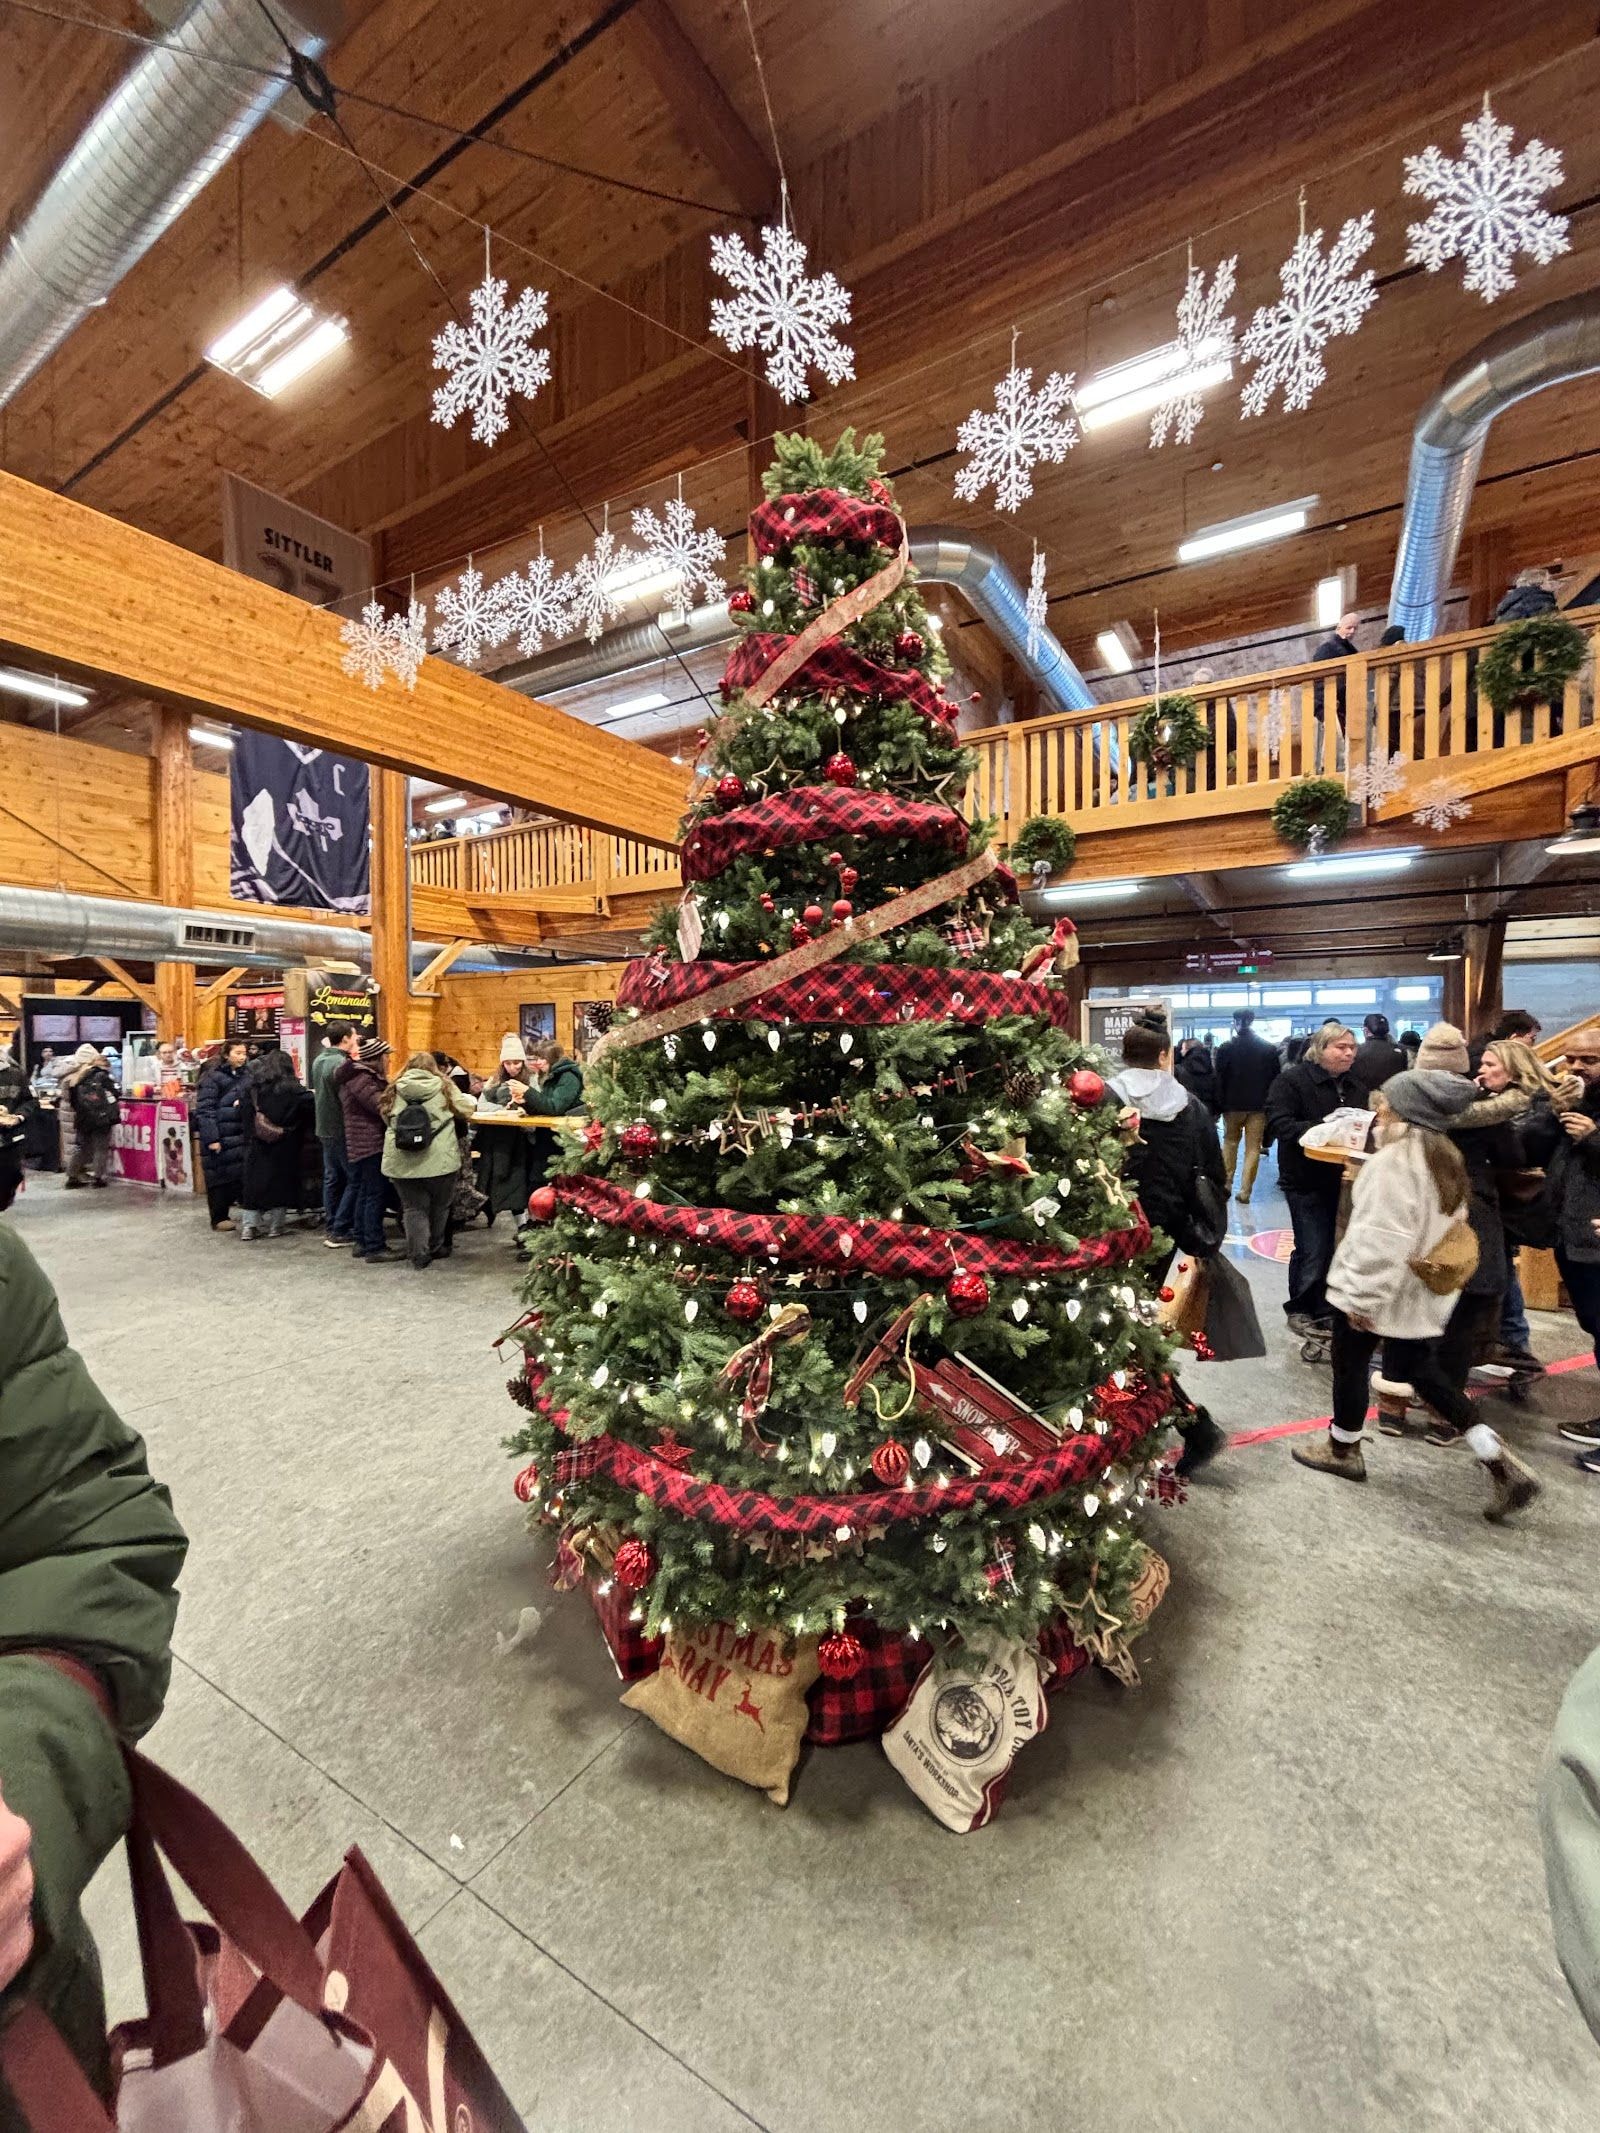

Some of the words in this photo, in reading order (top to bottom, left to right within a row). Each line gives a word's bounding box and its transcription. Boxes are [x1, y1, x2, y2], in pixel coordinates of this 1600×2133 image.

[264, 527, 333, 573] SITTLER
[310, 985, 371, 1010] Lemonade
[952, 1398, 988, 1425] SNOW
[1011, 1696, 1033, 1730] TOY
[903, 1730, 925, 1760] SANTA'S
[922, 1758, 960, 1798] WORKSHOP
